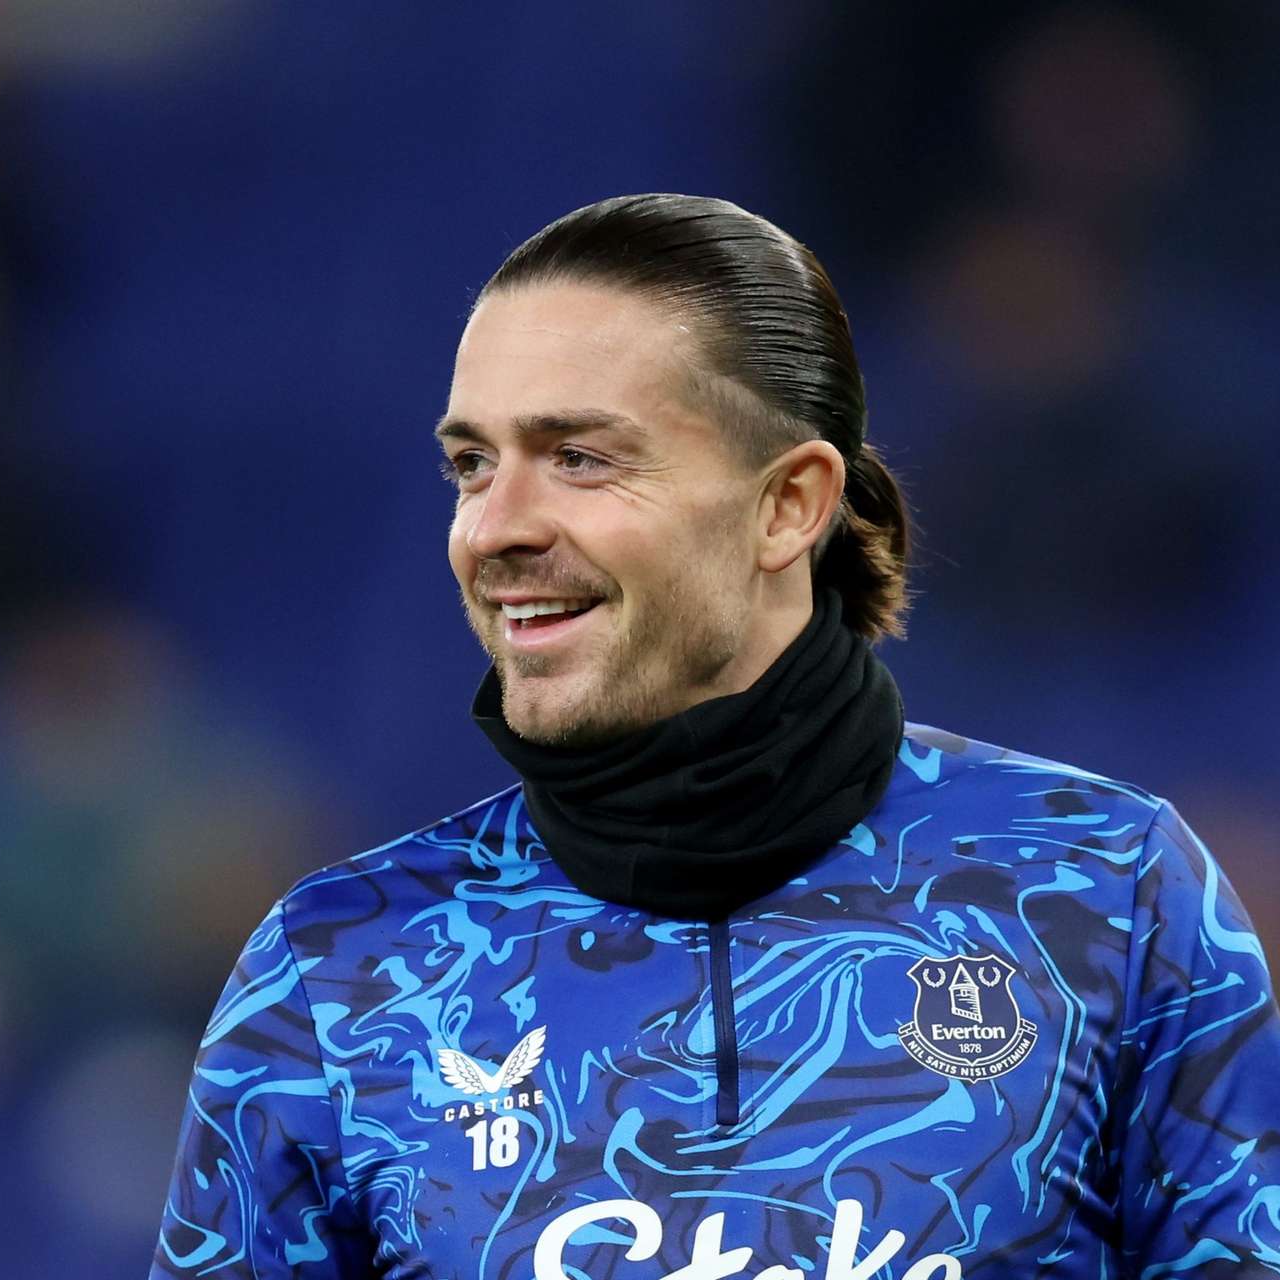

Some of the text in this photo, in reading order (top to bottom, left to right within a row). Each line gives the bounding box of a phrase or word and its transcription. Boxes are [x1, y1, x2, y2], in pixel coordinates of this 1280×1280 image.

[931, 1023, 1006, 1041] Everton
[959, 1043, 982, 1054] 1878
[908, 1039, 1031, 1078] NIL SATIS NISI OPTIMUM
[444, 1089, 544, 1122] CASTORE
[465, 1115, 520, 1171] 18
